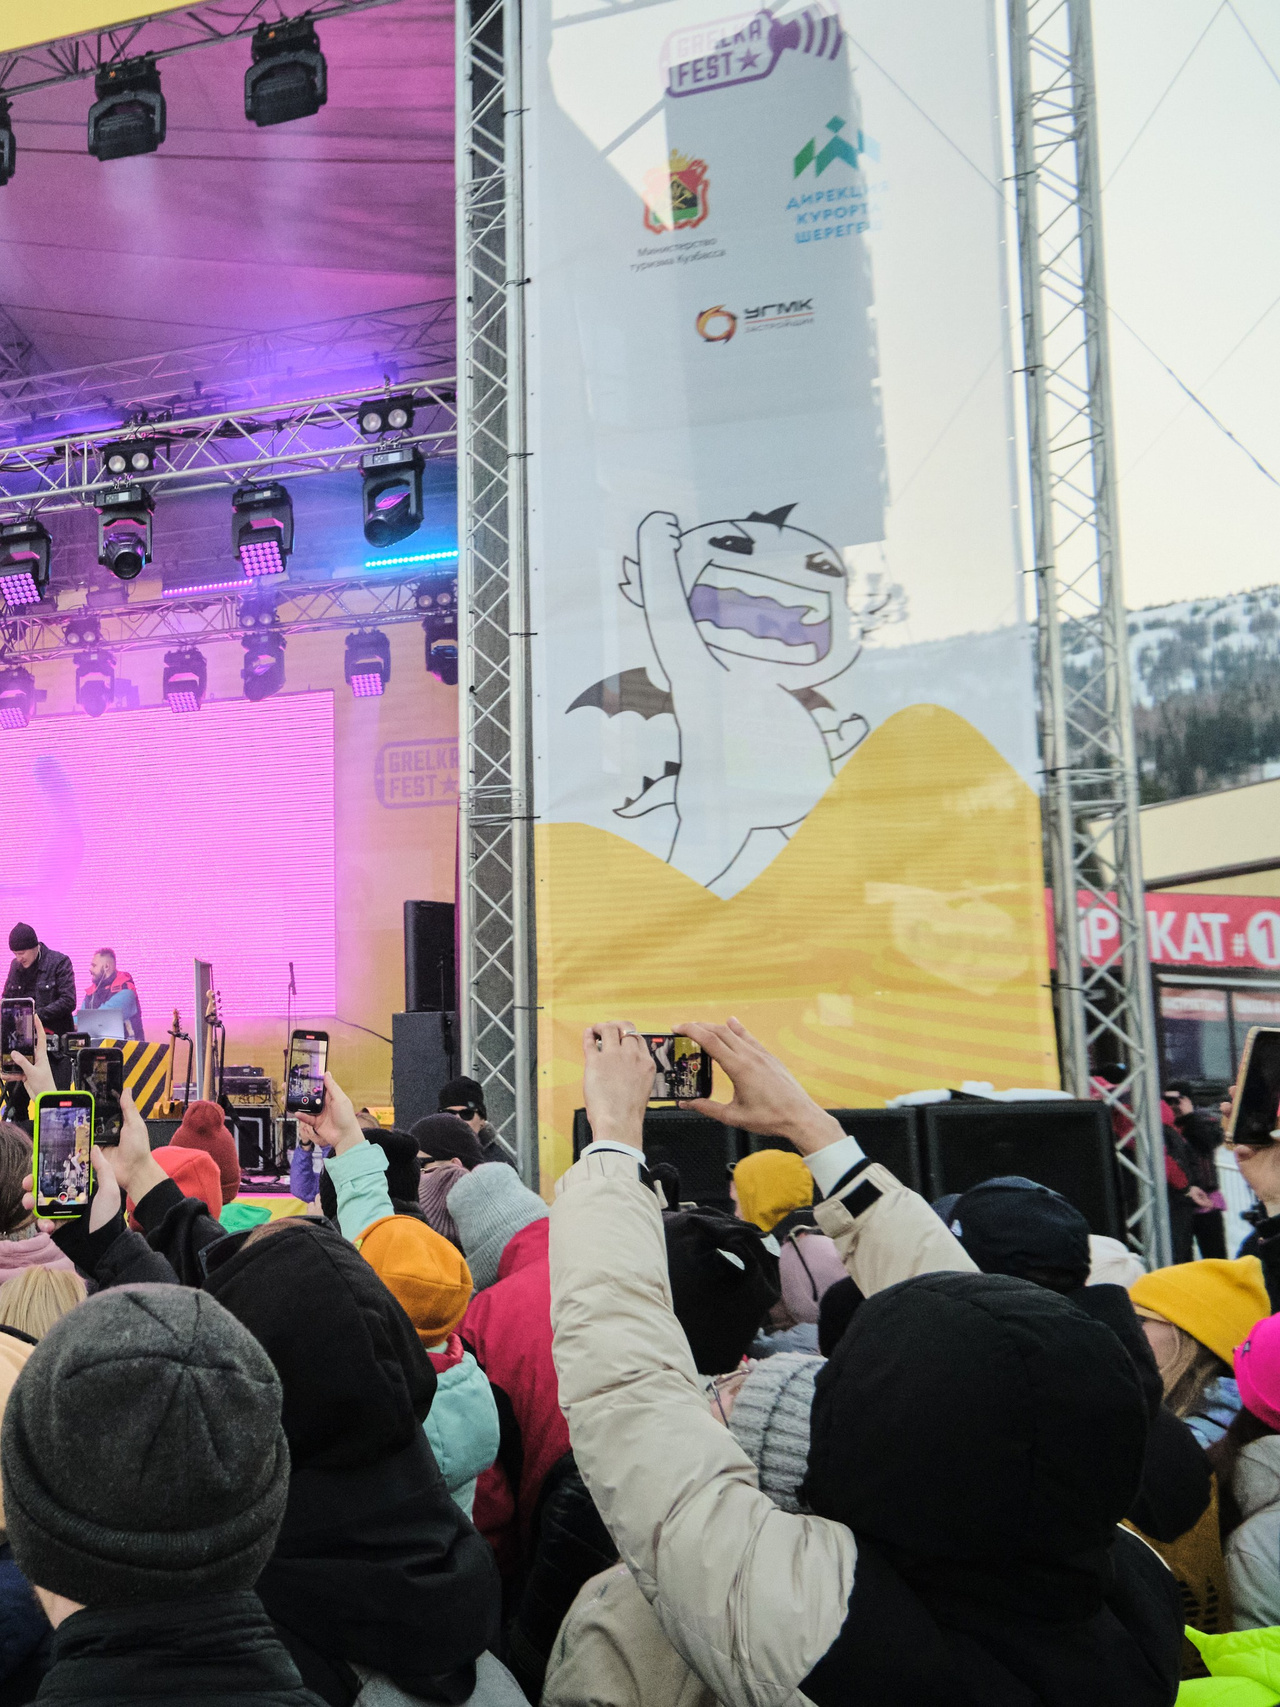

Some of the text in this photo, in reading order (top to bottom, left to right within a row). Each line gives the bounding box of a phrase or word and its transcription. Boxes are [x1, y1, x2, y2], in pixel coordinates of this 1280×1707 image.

[678, 51, 733, 86] FEST
[637, 237, 718, 257] Министерство
[744, 298, 813, 320] УГМК
[389, 774, 438, 800] FEST
